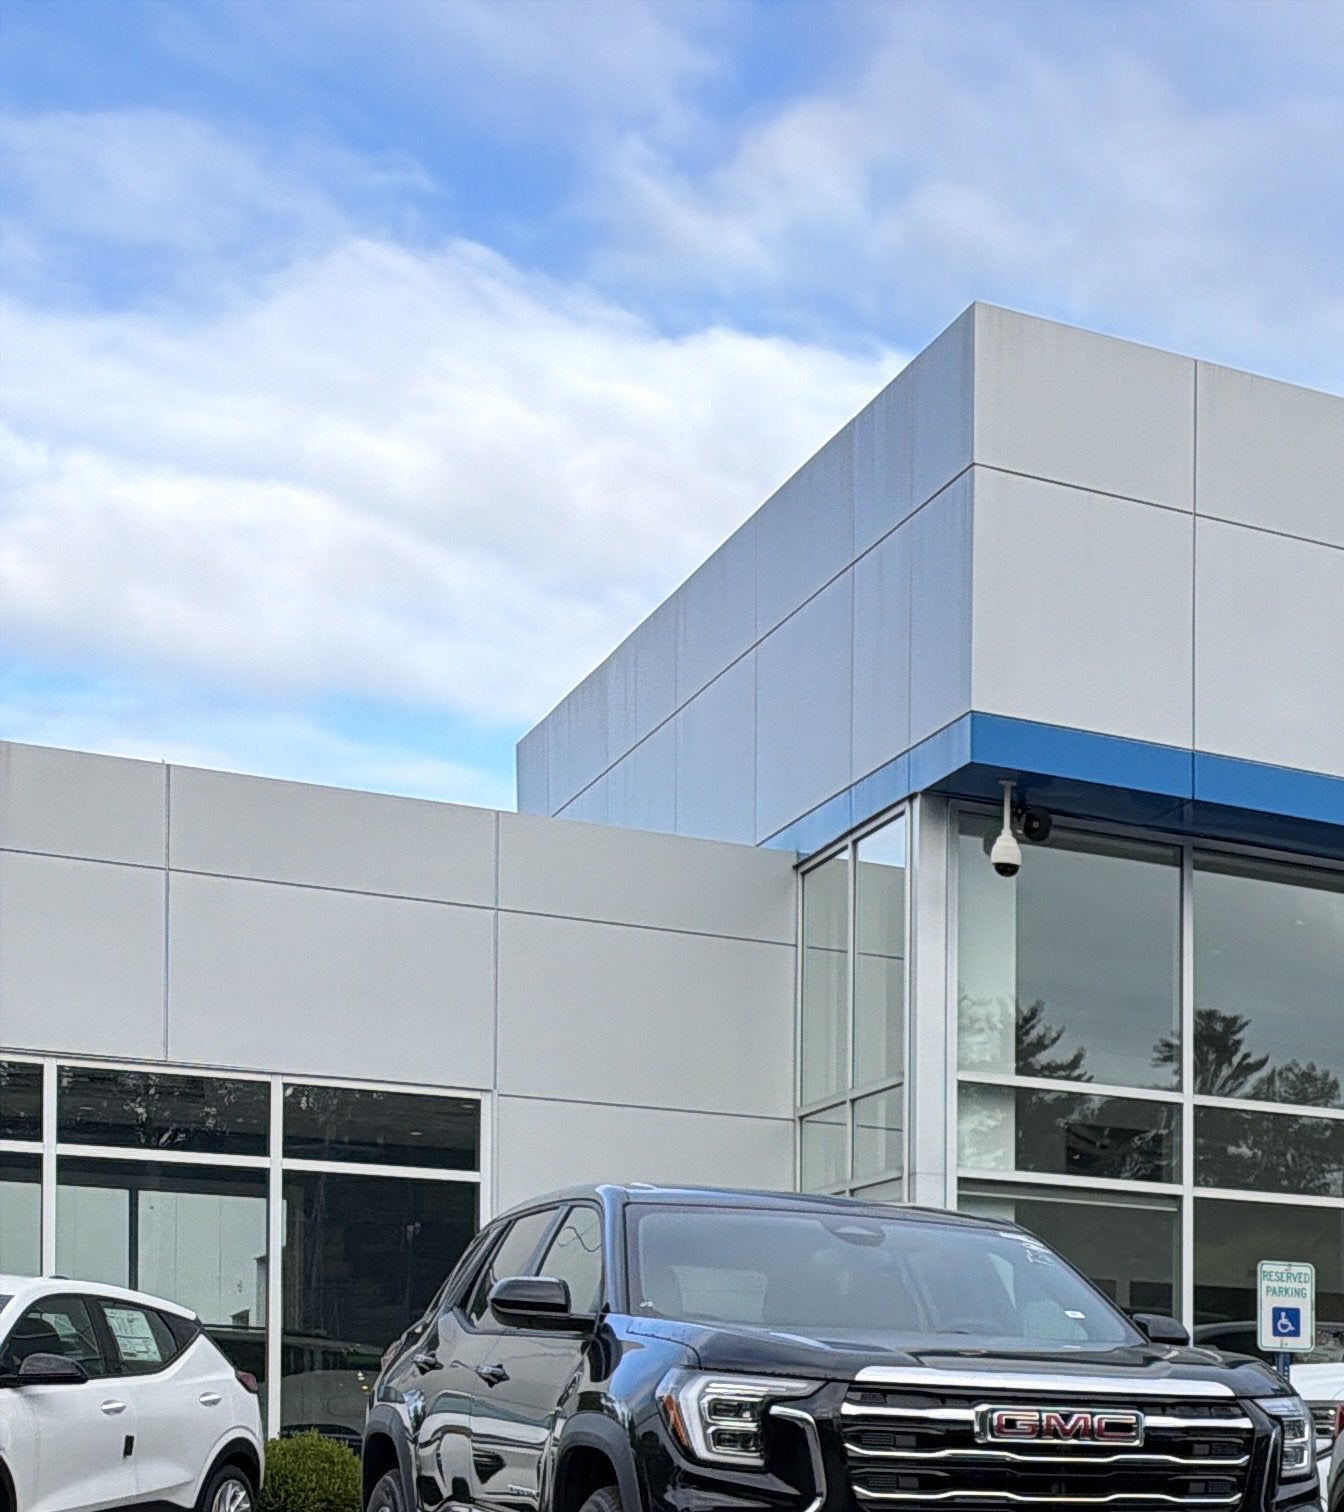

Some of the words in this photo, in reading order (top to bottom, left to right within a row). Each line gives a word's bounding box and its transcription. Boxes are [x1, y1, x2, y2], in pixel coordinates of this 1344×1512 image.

[1262, 1270, 1310, 1284] RESERVED
[1265, 1286, 1307, 1298] PARKING
[993, 1411, 1137, 1441] GMC
